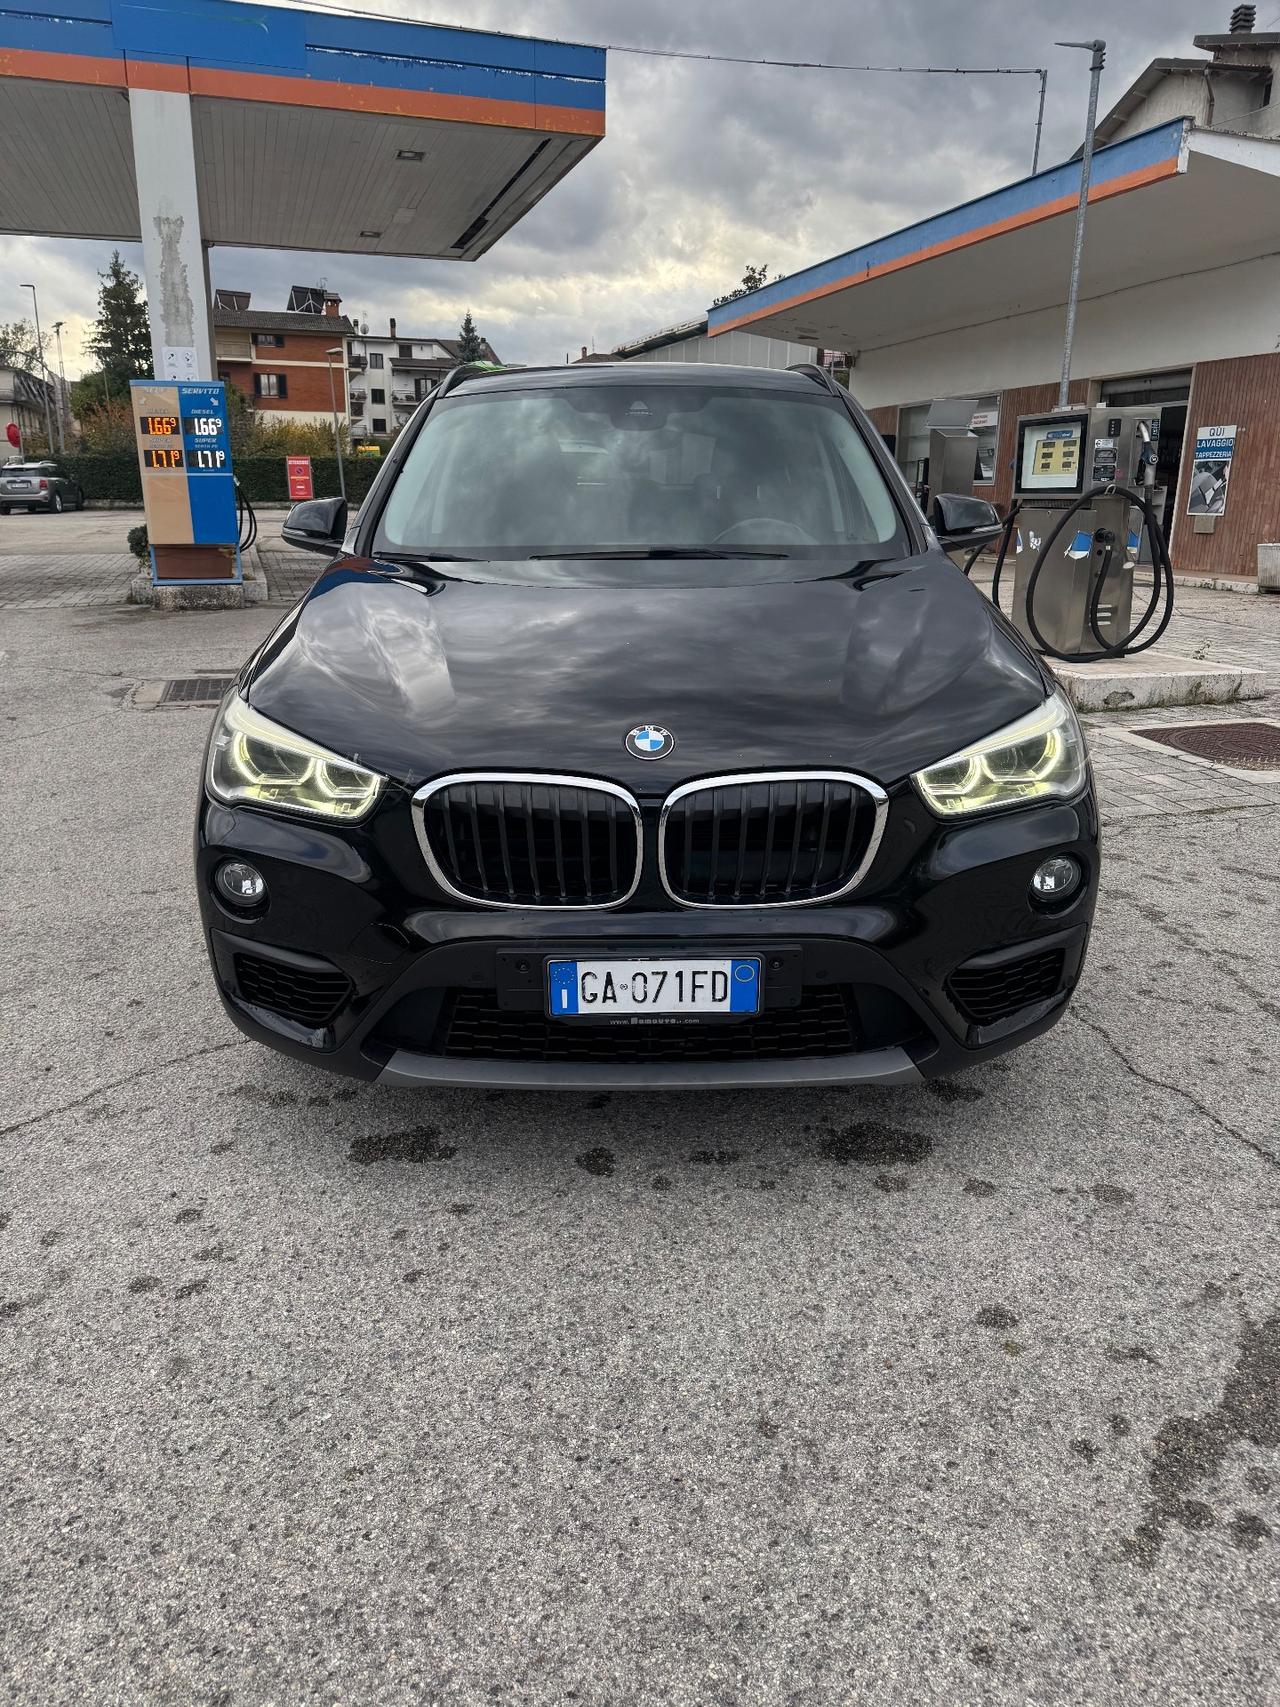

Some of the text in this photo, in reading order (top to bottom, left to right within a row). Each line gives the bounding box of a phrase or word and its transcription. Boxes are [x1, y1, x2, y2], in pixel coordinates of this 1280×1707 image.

[181, 387, 220, 395] SERVITO
[1196, 438, 1234, 448] LAVAGGIO
[1195, 450, 1232, 458] TAPPEZZERIA
